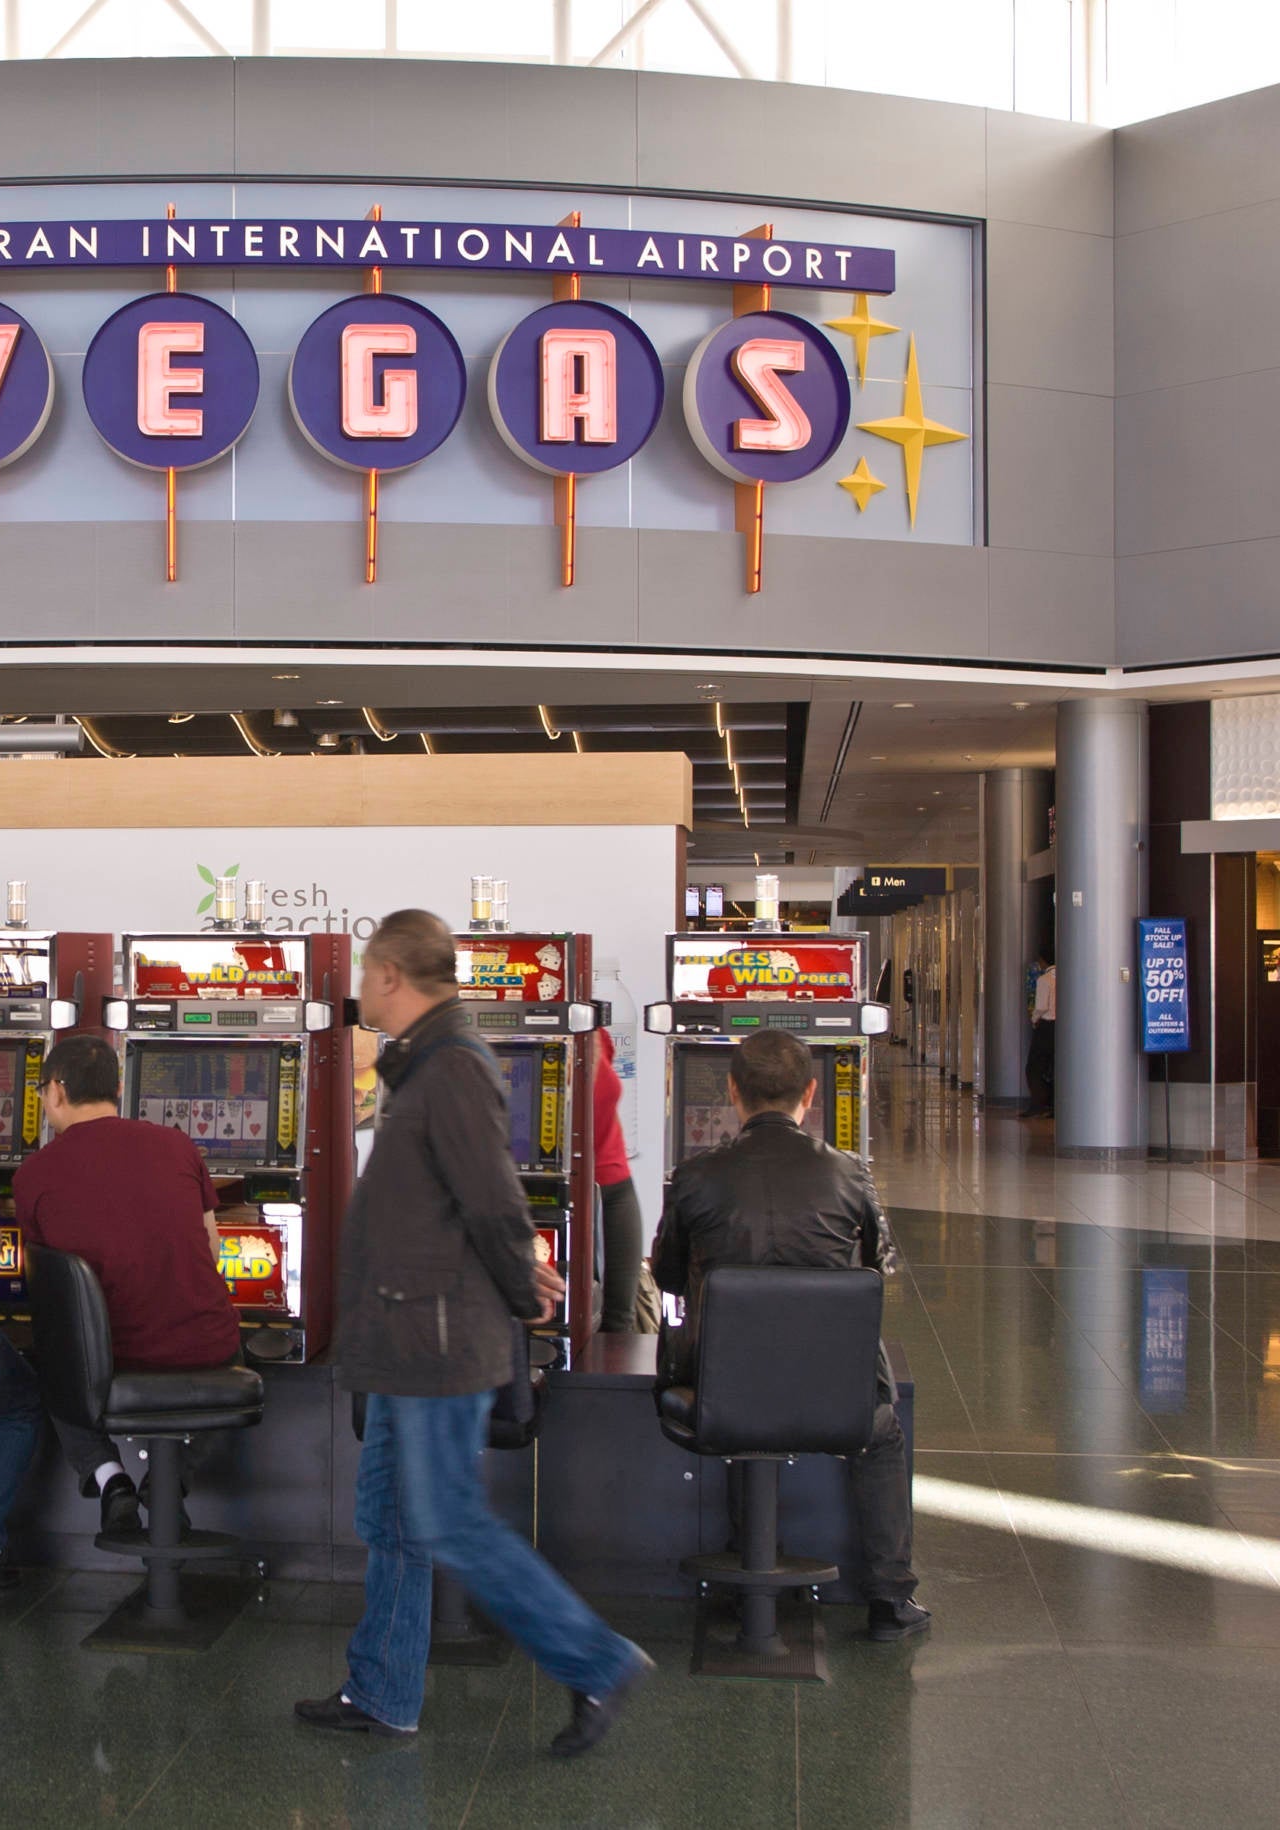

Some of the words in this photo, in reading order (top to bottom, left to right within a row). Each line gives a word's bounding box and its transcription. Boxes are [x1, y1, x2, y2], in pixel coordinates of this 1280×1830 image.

[142, 225, 604, 266] INTERNATIONAL
[637, 236, 854, 283] AIRPORT
[884, 877, 906, 886] Men
[265, 883, 328, 907] esh
[1145, 934, 1169, 942] STOCK
[1153, 941, 1174, 949] SALE!
[1146, 958, 1164, 968] UP
[1166, 957, 1183, 968] TO
[247, 972, 295, 983] POKER
[479, 975, 524, 986] POKER
[732, 967, 796, 984] WILD
[798, 974, 851, 985] POKER
[1146, 969, 1184, 987] 50%
[1146, 988, 1184, 1003] OFF!
